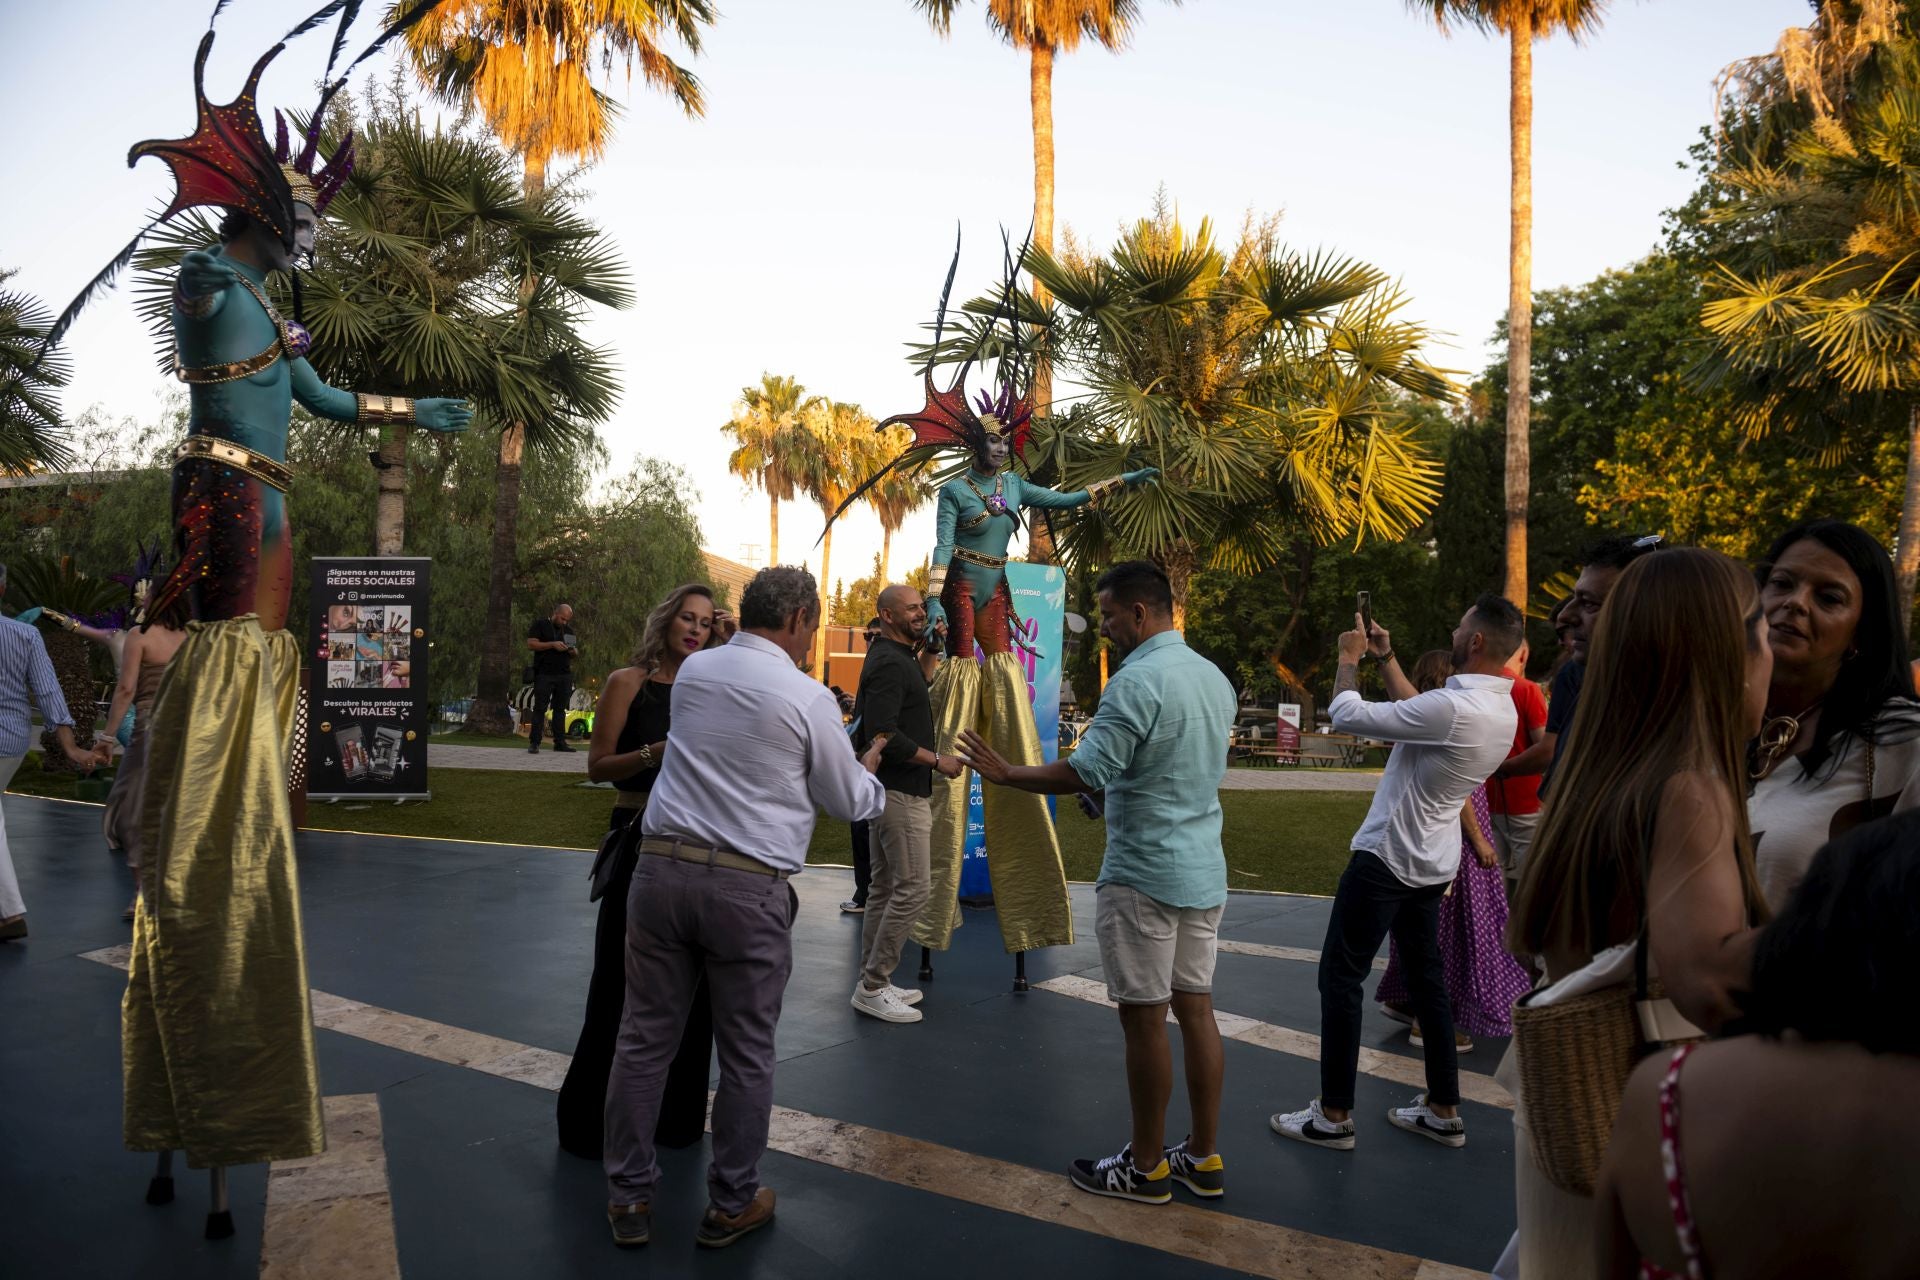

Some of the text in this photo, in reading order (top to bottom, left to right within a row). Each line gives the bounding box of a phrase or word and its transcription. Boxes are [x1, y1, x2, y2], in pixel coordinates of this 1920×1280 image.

[327, 569, 366, 577] ¡Síguenos
[326, 577, 415, 585] REDES SOCIALES!
[374, 700, 413, 708] productos
[348, 707, 397, 716] VIRALES
[1106, 1165, 1138, 1193] AX
